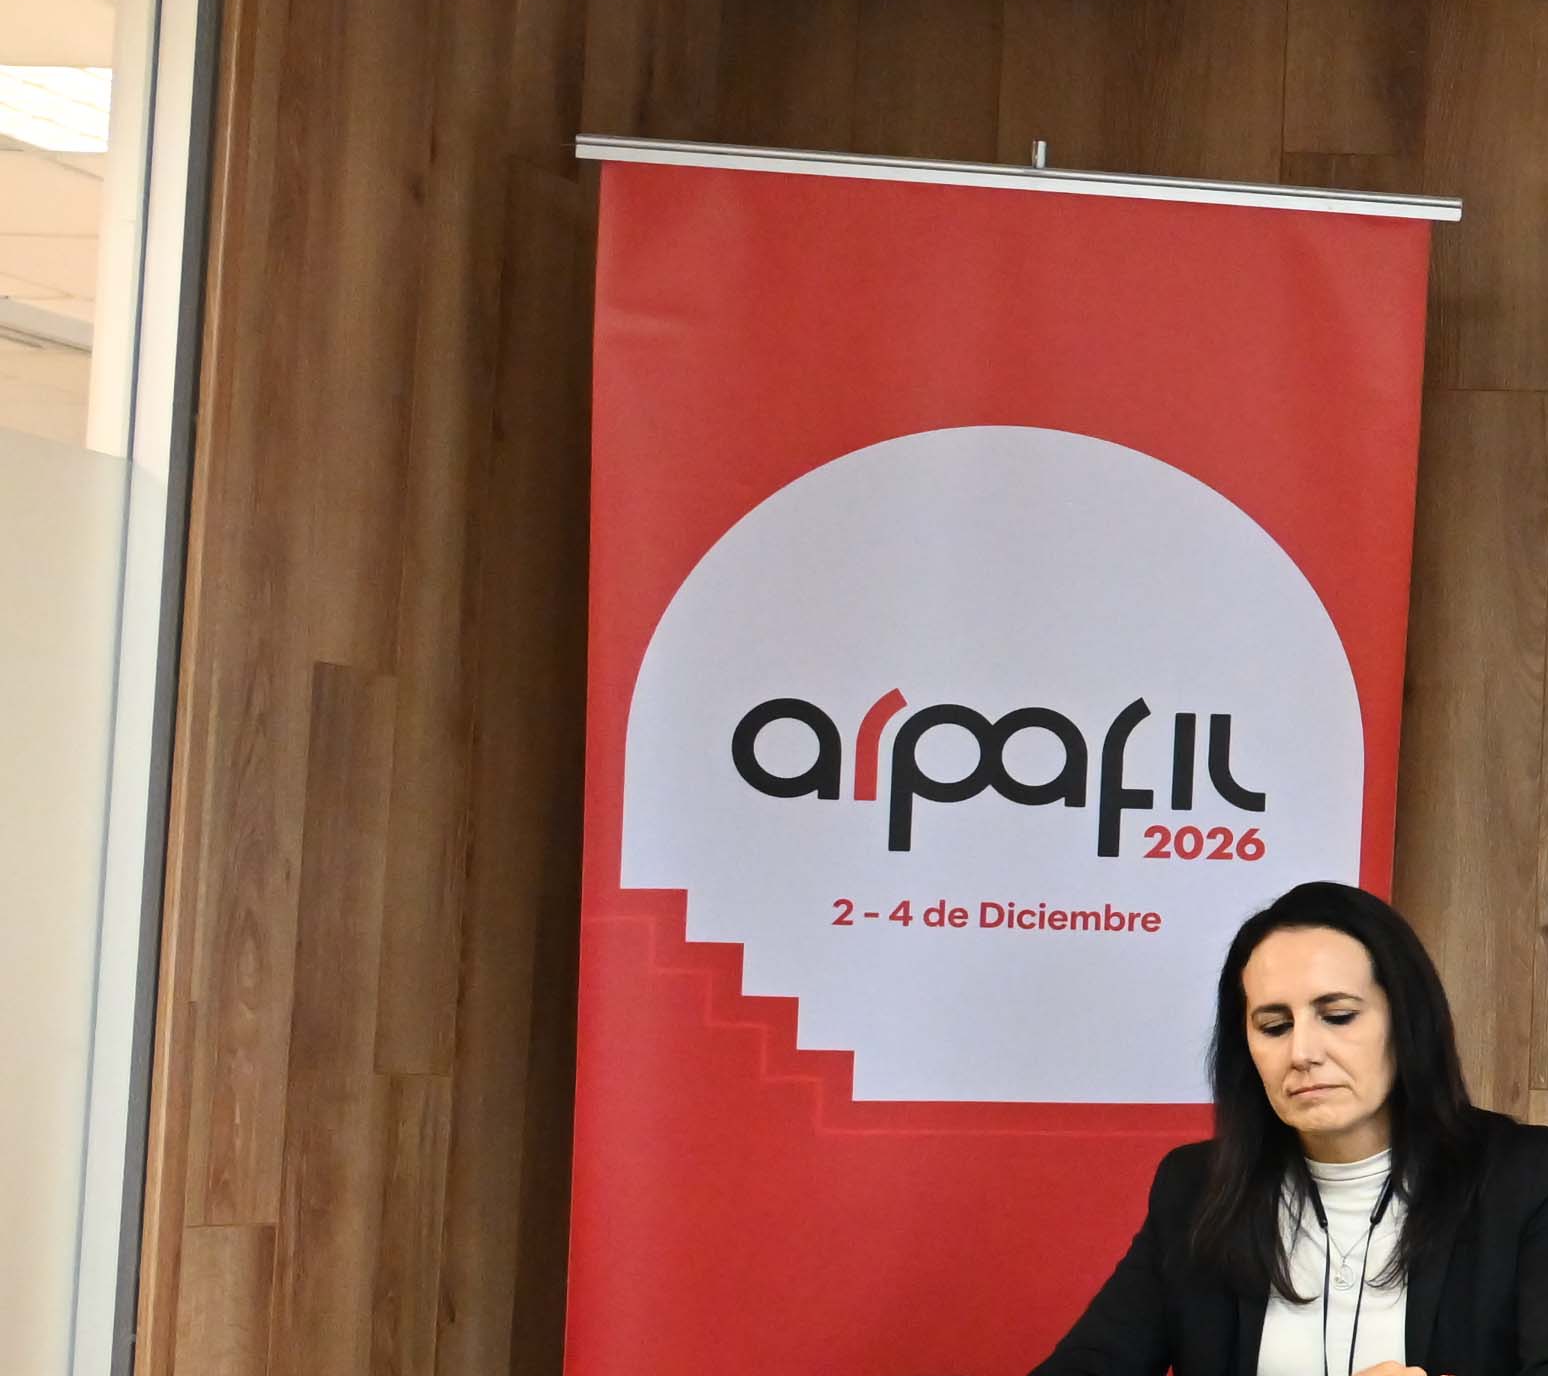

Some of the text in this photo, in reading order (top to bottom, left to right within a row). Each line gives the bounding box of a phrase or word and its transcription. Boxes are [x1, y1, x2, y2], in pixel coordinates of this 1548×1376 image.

[1143, 826, 1266, 861] 2026
[831, 898, 854, 926] 2
[889, 900, 913, 928] 4
[922, 899, 969, 930] de
[980, 901, 1163, 934] Diciembre
